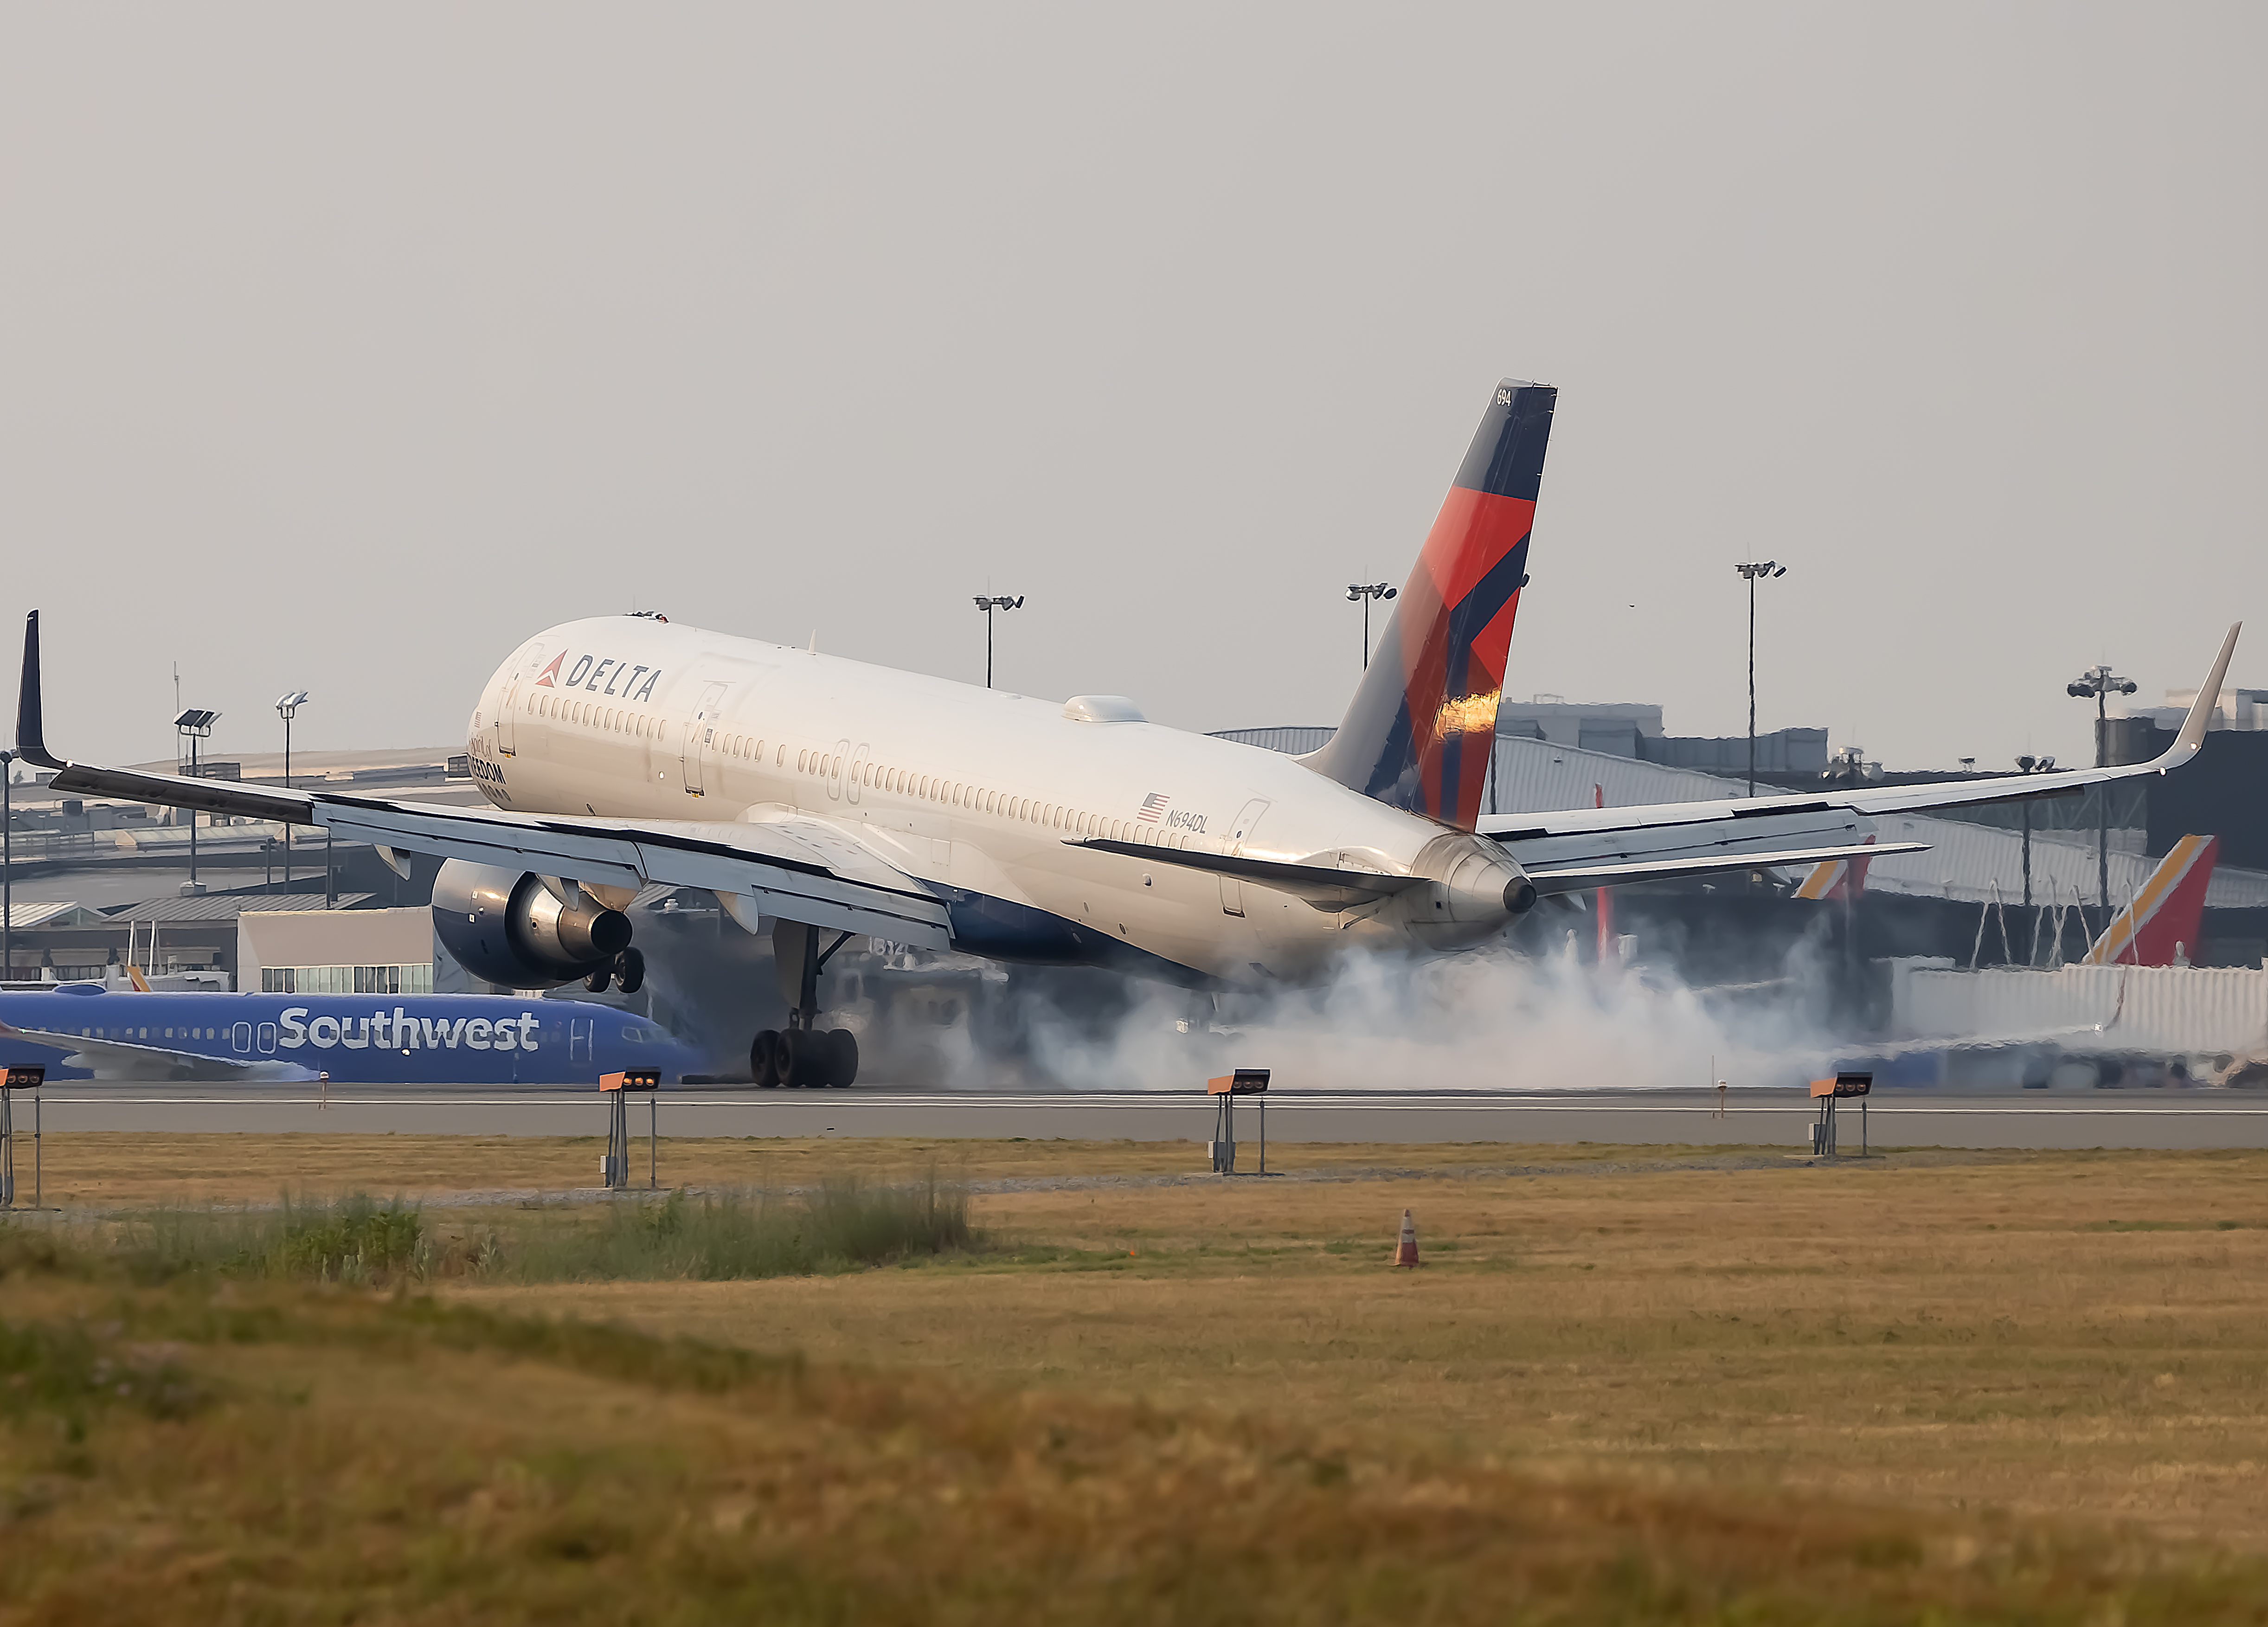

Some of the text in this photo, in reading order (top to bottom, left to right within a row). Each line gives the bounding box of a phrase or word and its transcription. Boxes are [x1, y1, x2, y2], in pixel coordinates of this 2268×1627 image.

[1497, 388, 1511, 406] 694
[565, 655, 662, 702] DELTA
[1166, 810, 1208, 834] N694DL
[279, 1007, 540, 1051] Southwest
